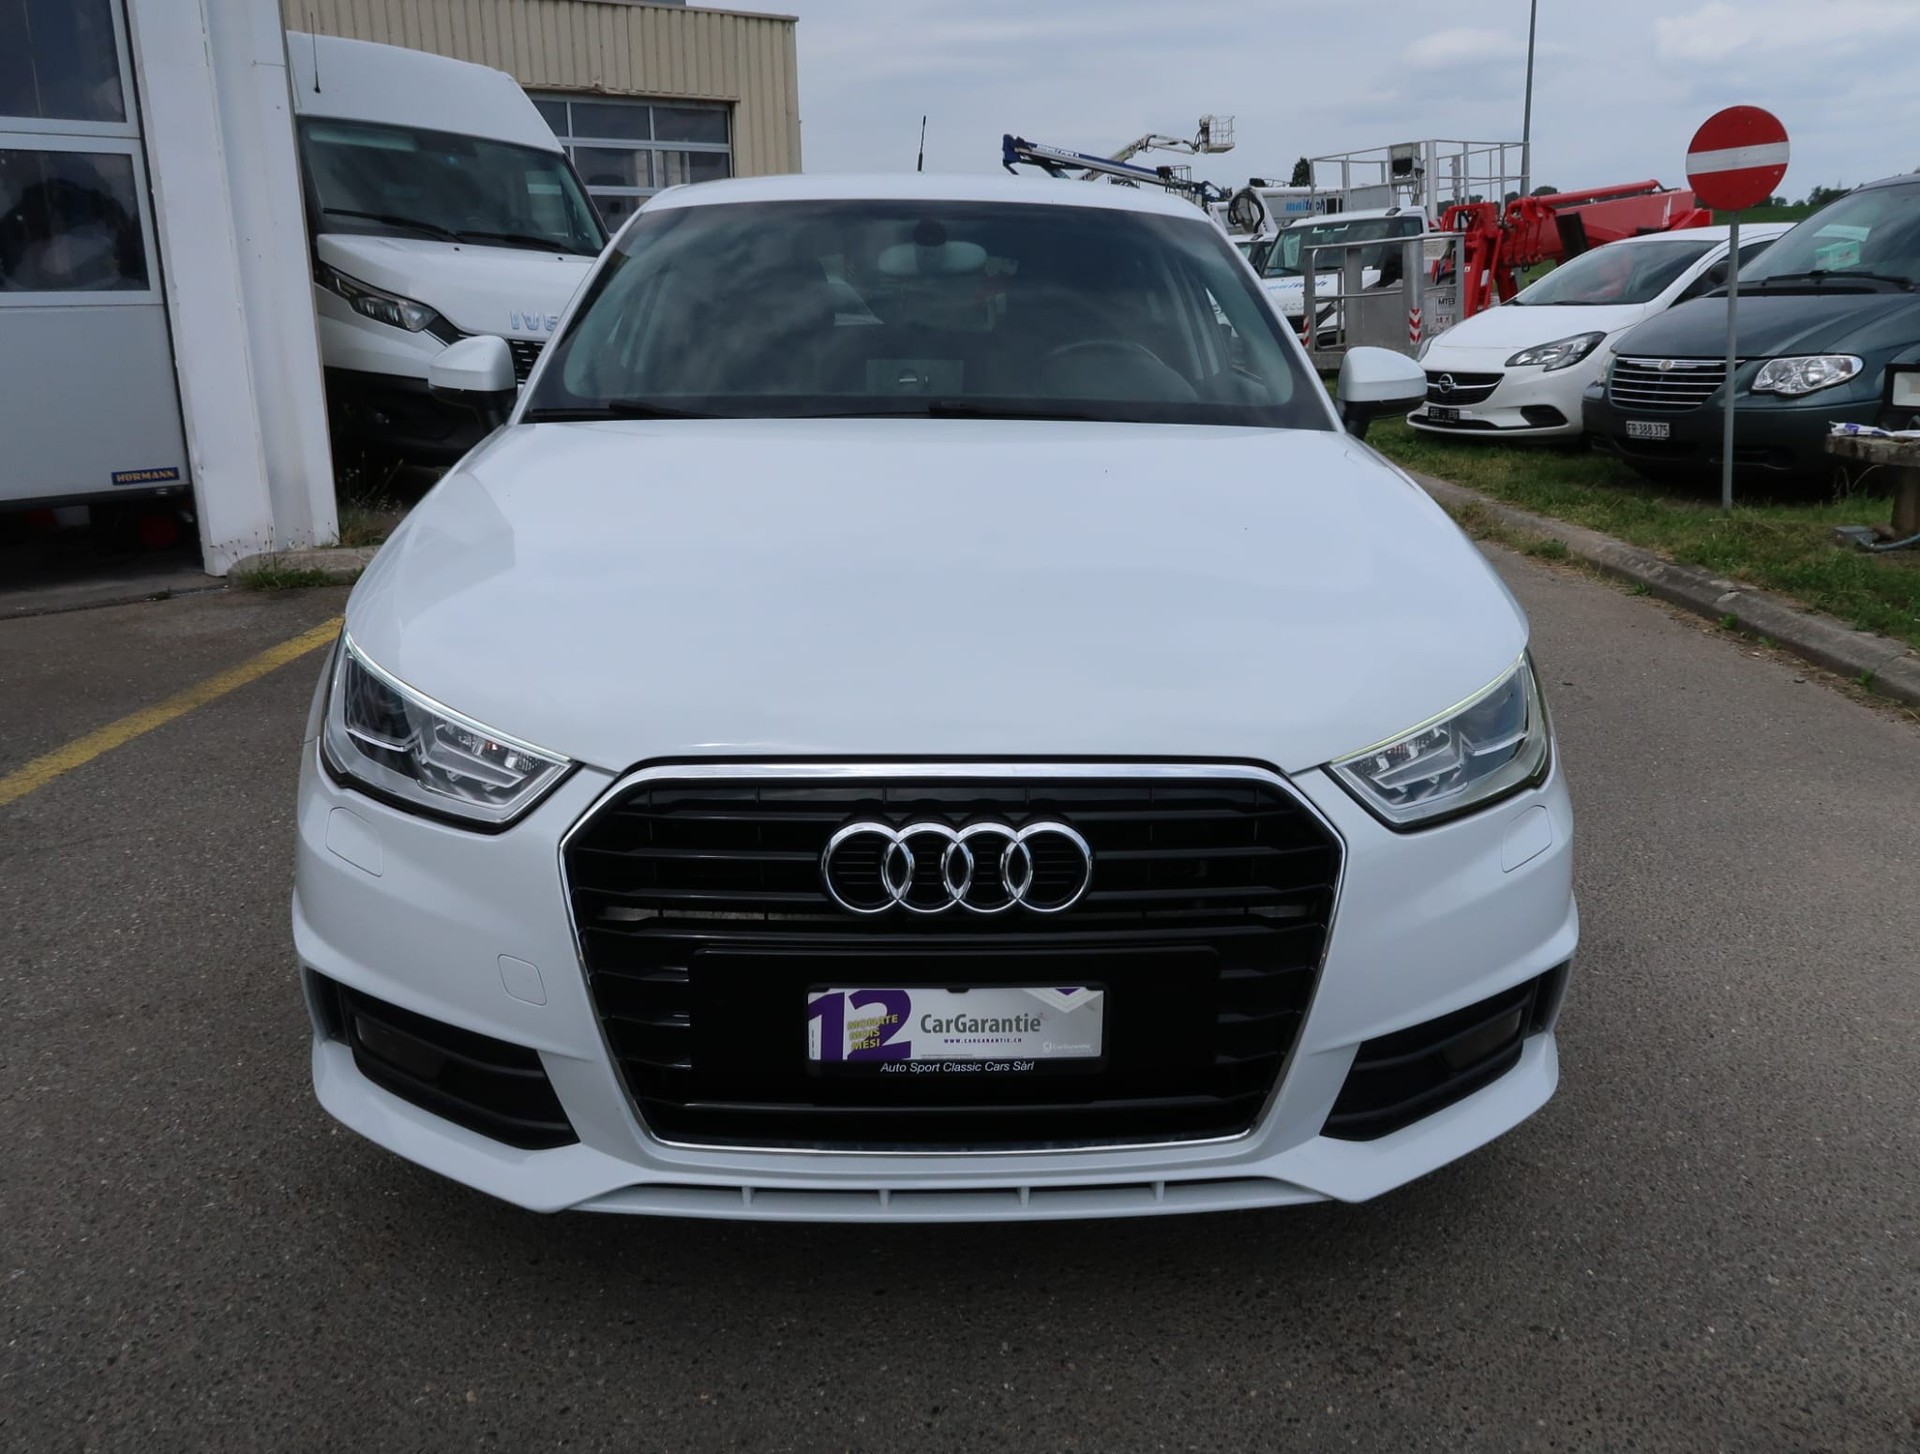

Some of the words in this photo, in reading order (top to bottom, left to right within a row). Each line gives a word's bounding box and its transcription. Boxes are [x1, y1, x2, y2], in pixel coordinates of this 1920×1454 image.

[510, 310, 559, 331] IVE
[847, 1014, 899, 1030] MONATE
[920, 1013, 1041, 1034] CarGarantie
[849, 1027, 880, 1041] MOIS
[880, 1063, 907, 1073] Auto
[909, 1063, 940, 1075] Sport
[942, 1062, 982, 1072] Classic
[984, 1061, 1010, 1071] Cars
